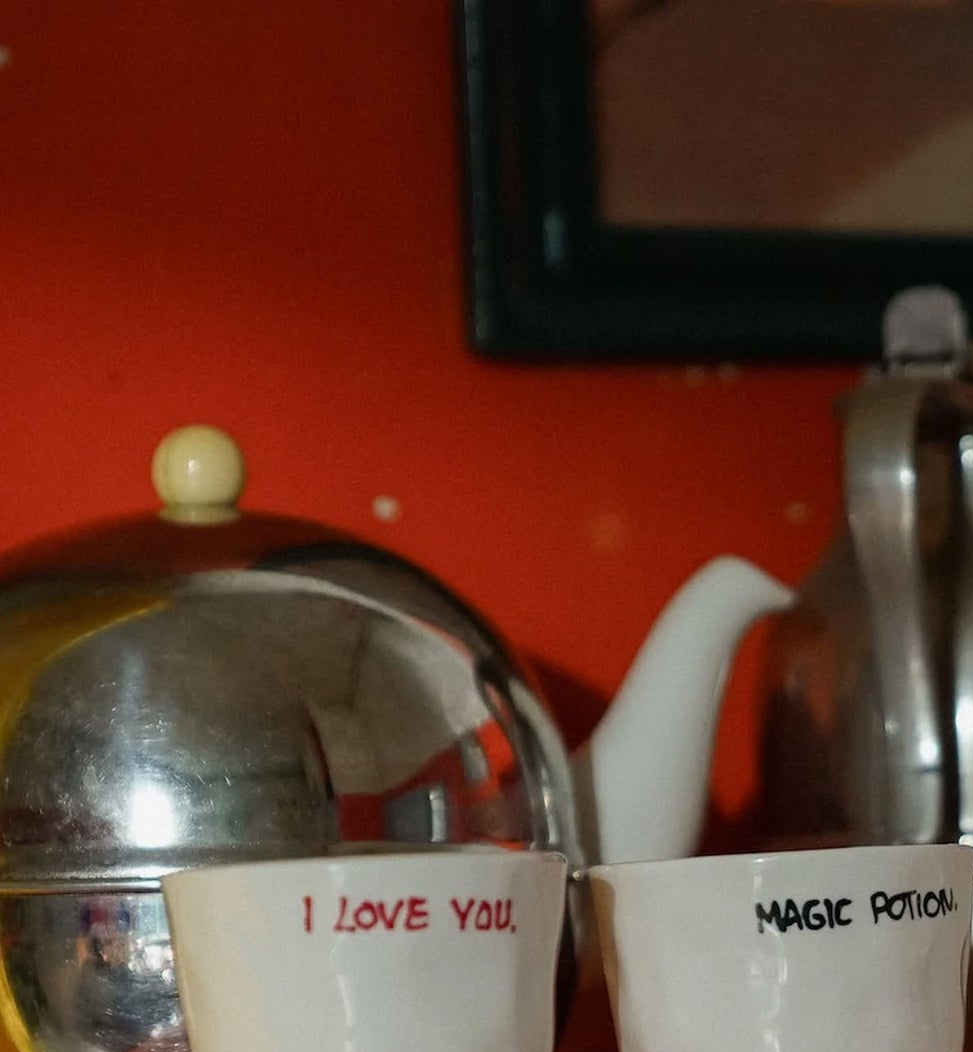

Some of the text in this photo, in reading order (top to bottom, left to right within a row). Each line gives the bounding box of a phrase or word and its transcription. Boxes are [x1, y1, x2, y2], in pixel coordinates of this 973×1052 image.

[303, 896, 517, 932] I LOVE YOU.
[754, 898, 853, 934] MAGIC
